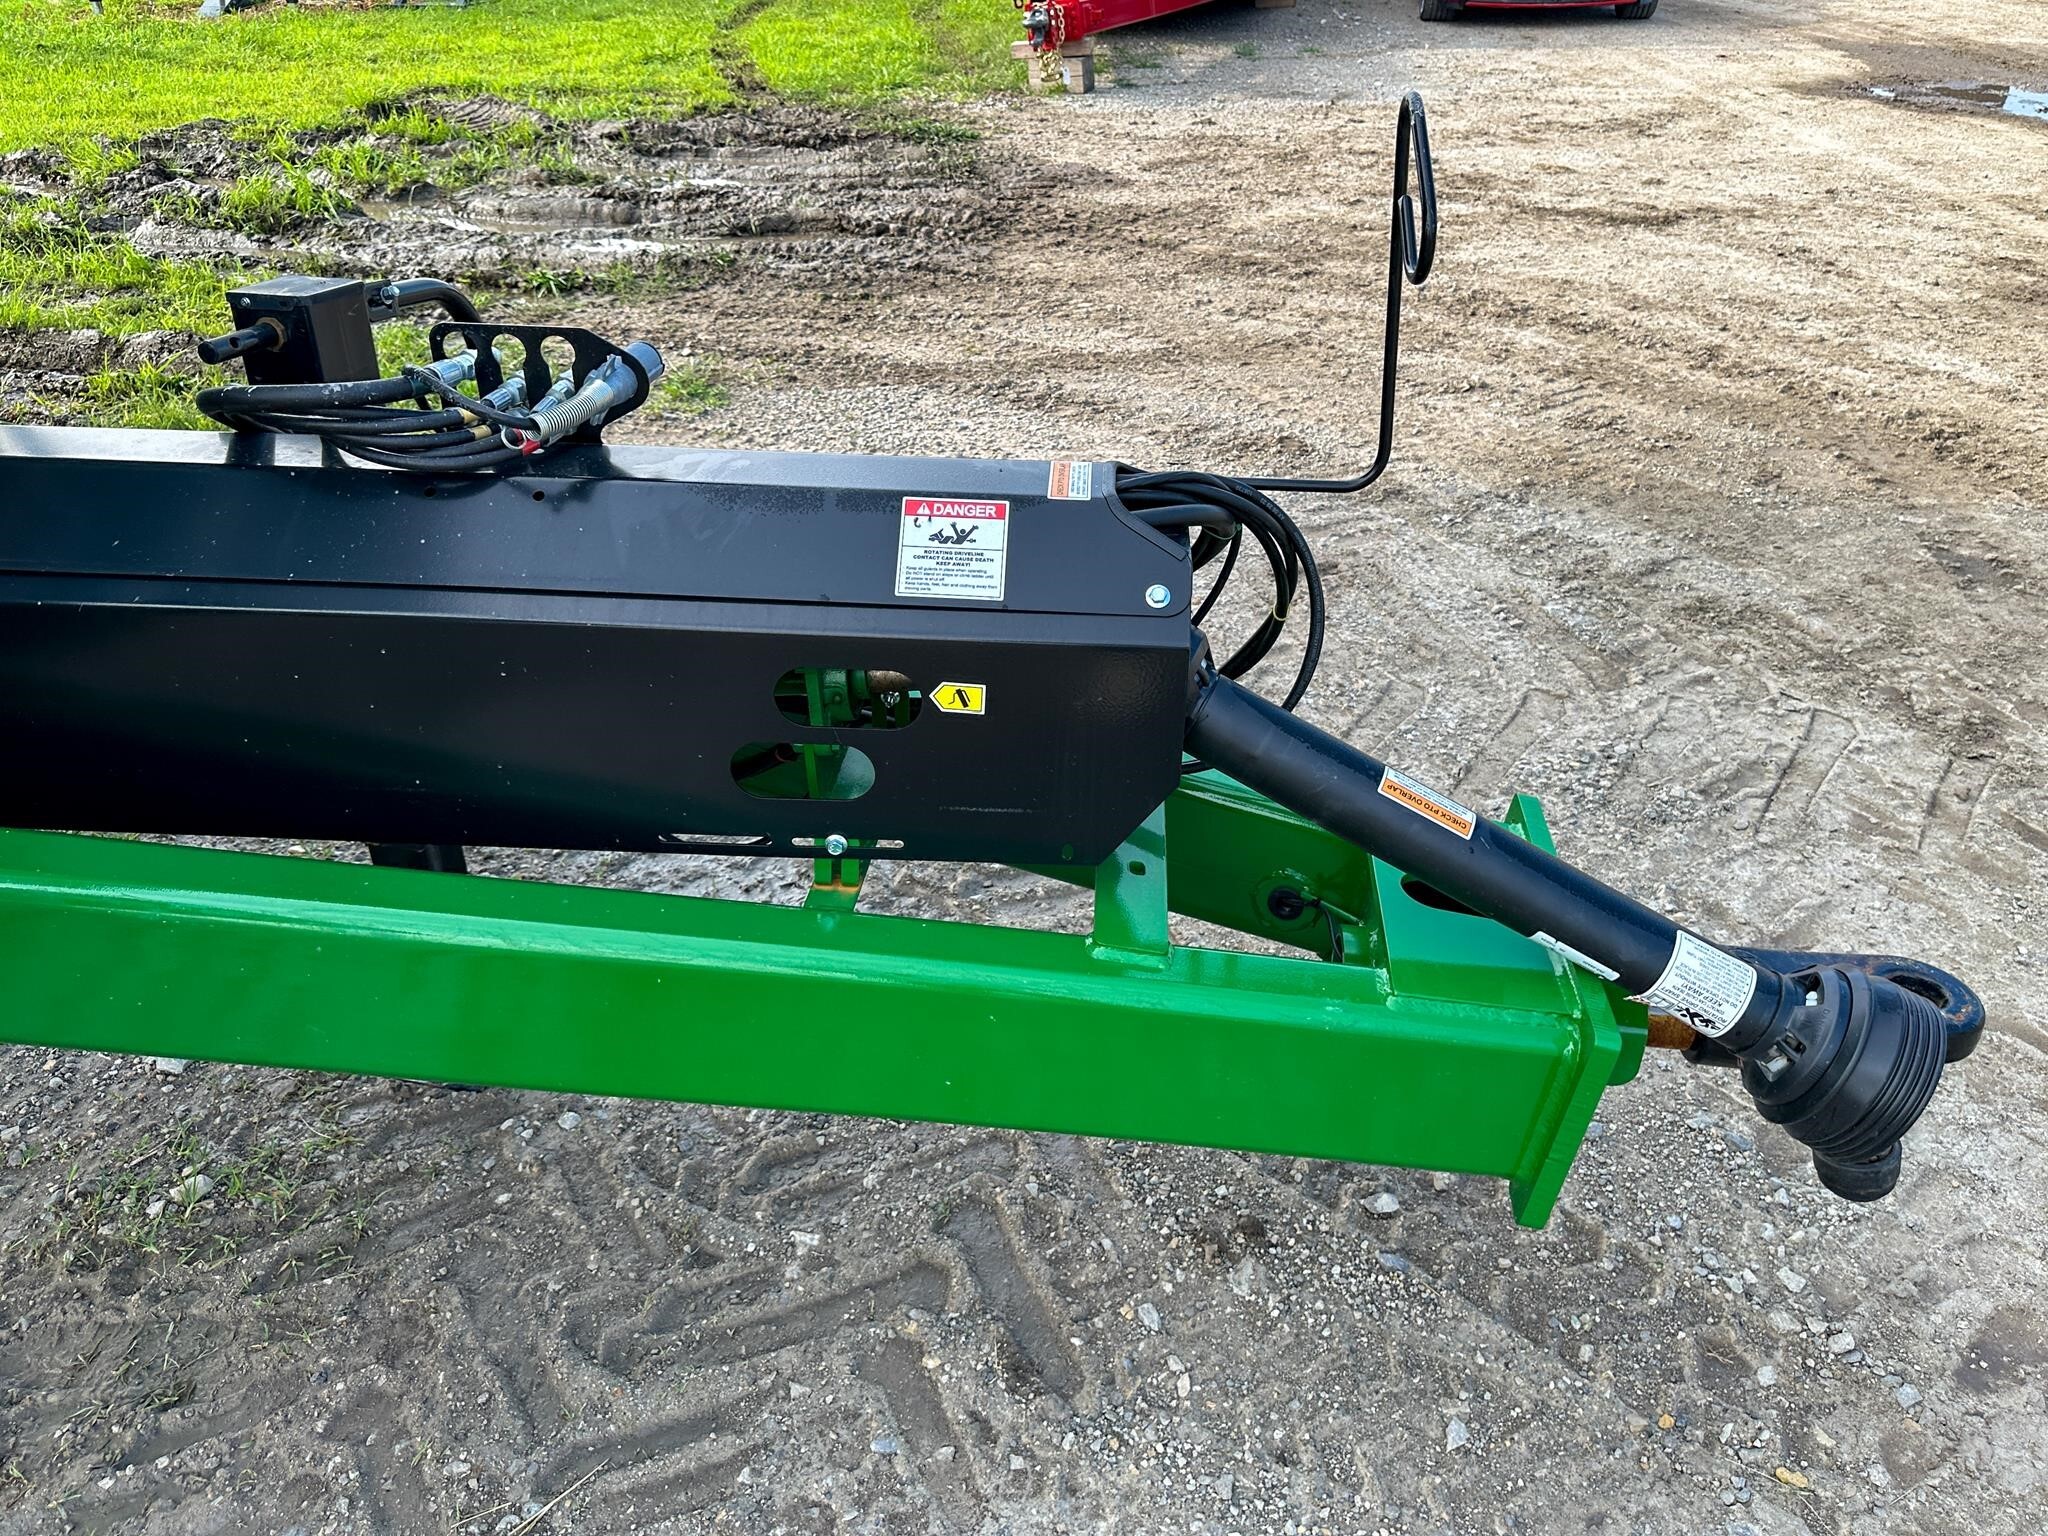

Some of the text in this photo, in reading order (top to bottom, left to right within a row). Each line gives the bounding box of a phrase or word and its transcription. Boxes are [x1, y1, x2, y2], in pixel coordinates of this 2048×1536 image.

[933, 503, 997, 517] DANGER
[1386, 783, 1424, 806] OVERLAP
[1423, 802, 1440, 815] PTO
[1439, 811, 1468, 830] CHECK
[1671, 984, 1686, 995] DEATH
[1680, 981, 1723, 1008] KEEP AWAY!
[1697, 984, 1720, 999] OPERATE
[1685, 992, 1699, 1002] CAUSE
[1719, 996, 1730, 1004] NOT
[1660, 985, 1728, 1024] ROTATING DRIVE SHAFT
[1706, 1003, 1725, 1016] CONTACT
[1729, 1001, 1738, 1009] DO
